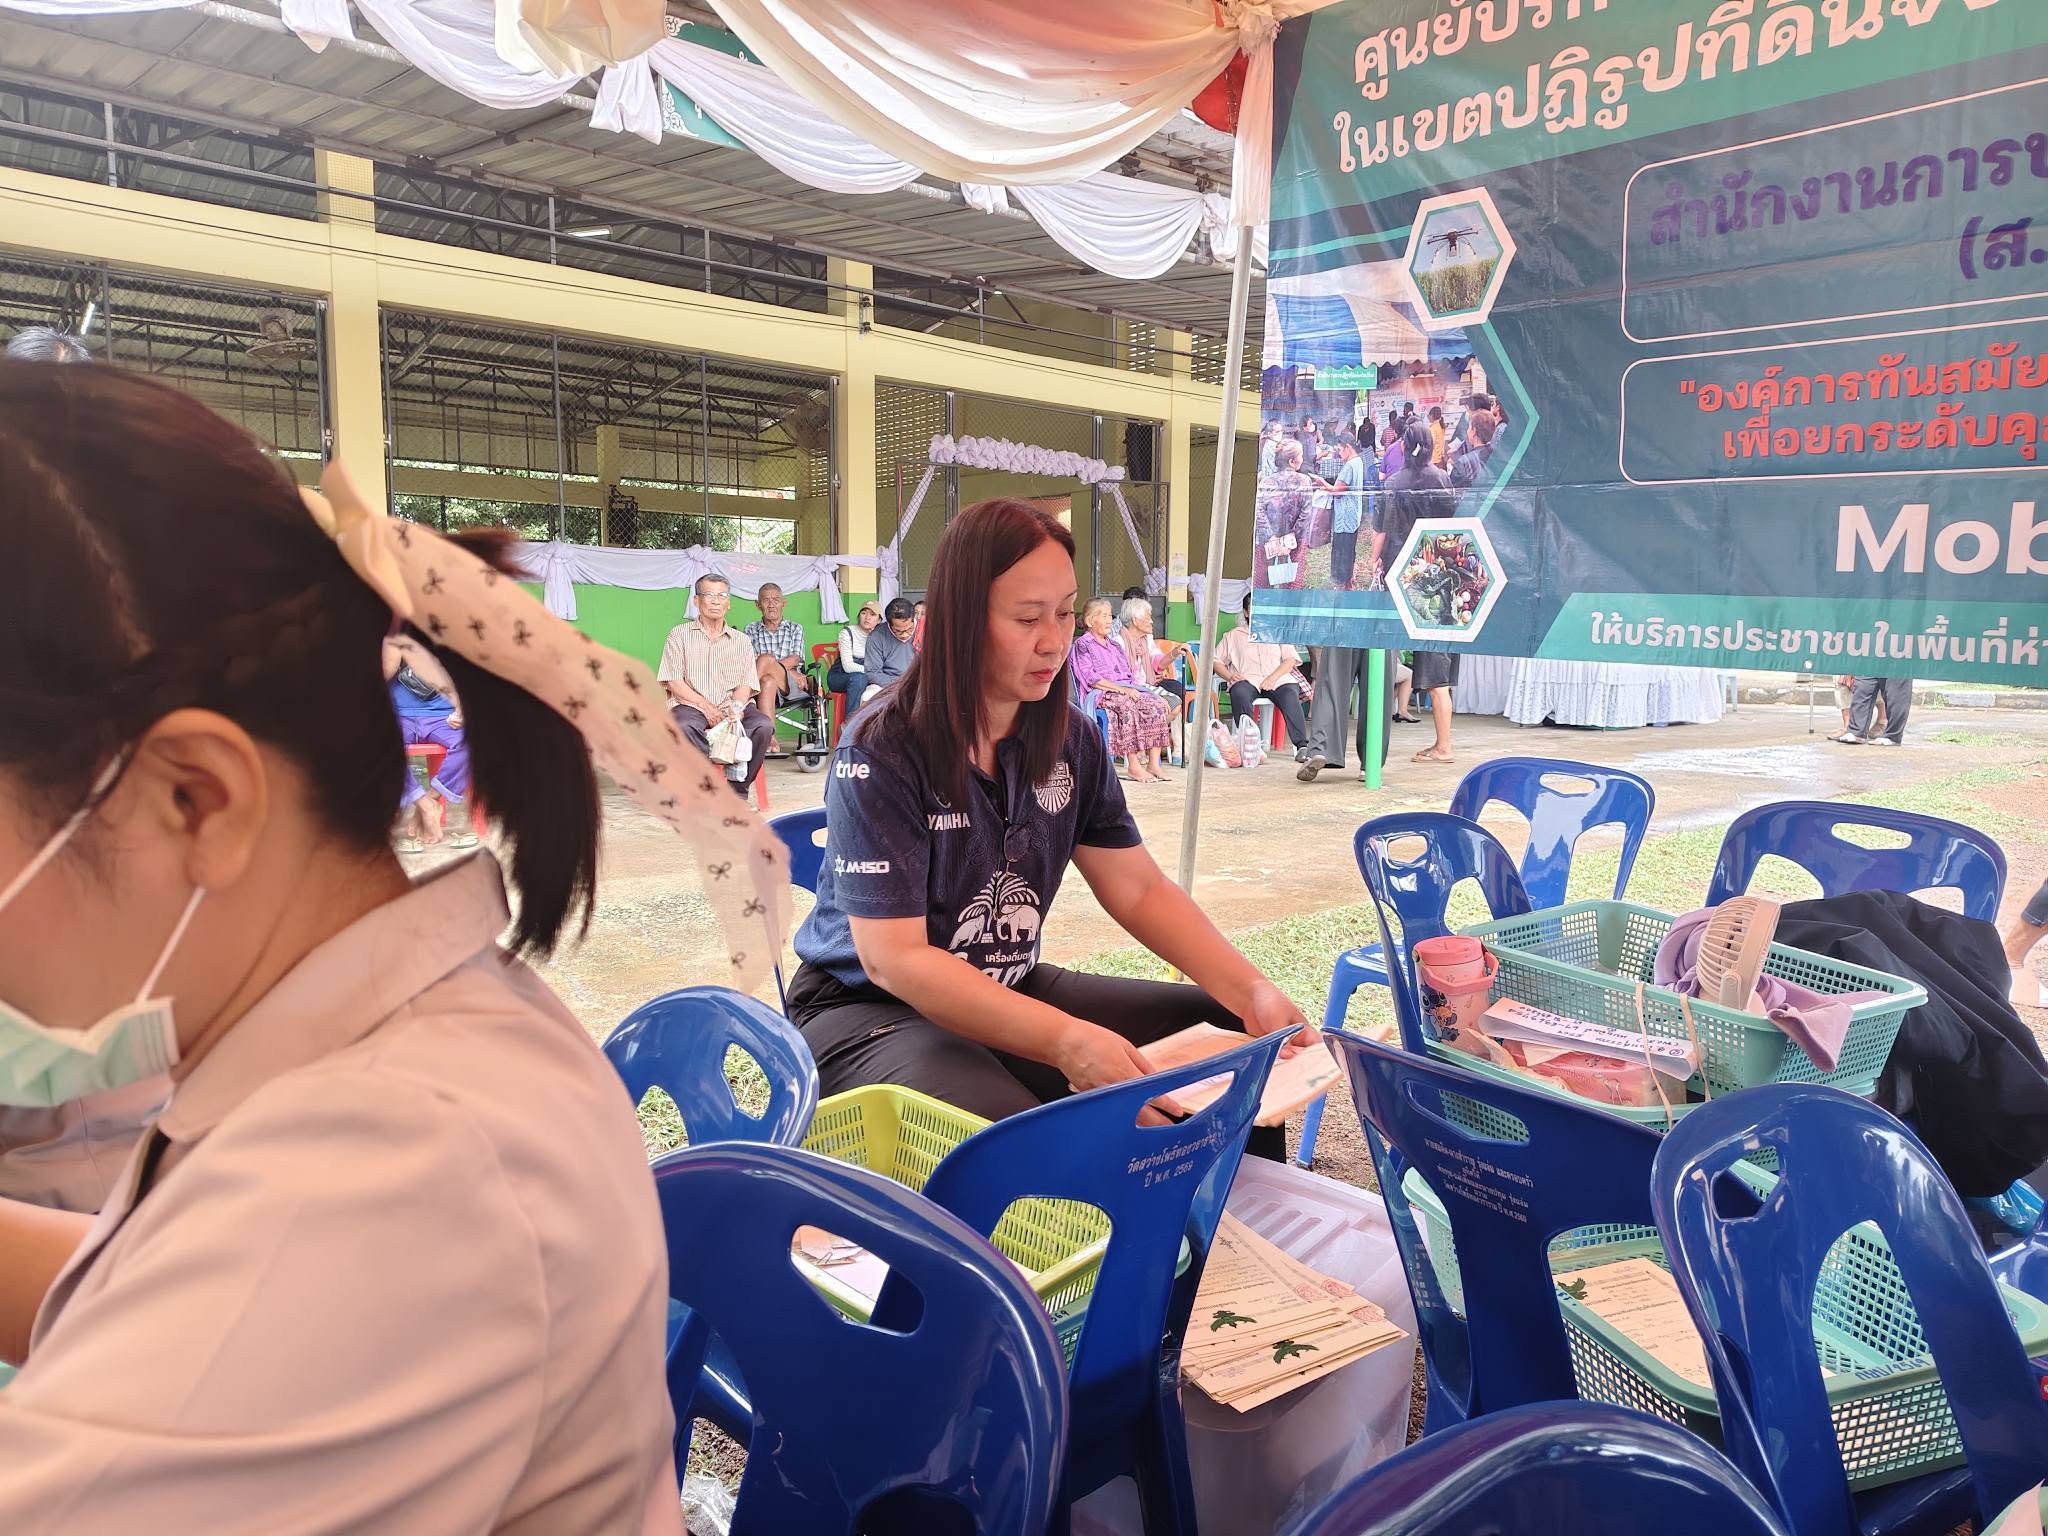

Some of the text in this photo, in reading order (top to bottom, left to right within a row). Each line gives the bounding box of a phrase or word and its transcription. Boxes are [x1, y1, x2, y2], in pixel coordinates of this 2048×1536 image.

[1723, 402, 2048, 461] เพื่อยกระดับคุ
[1591, 611, 2048, 666] ให้บริการประชาชนในพื้นที่ห่
[836, 760, 870, 779] true
[927, 812, 971, 831] YAMAHA
